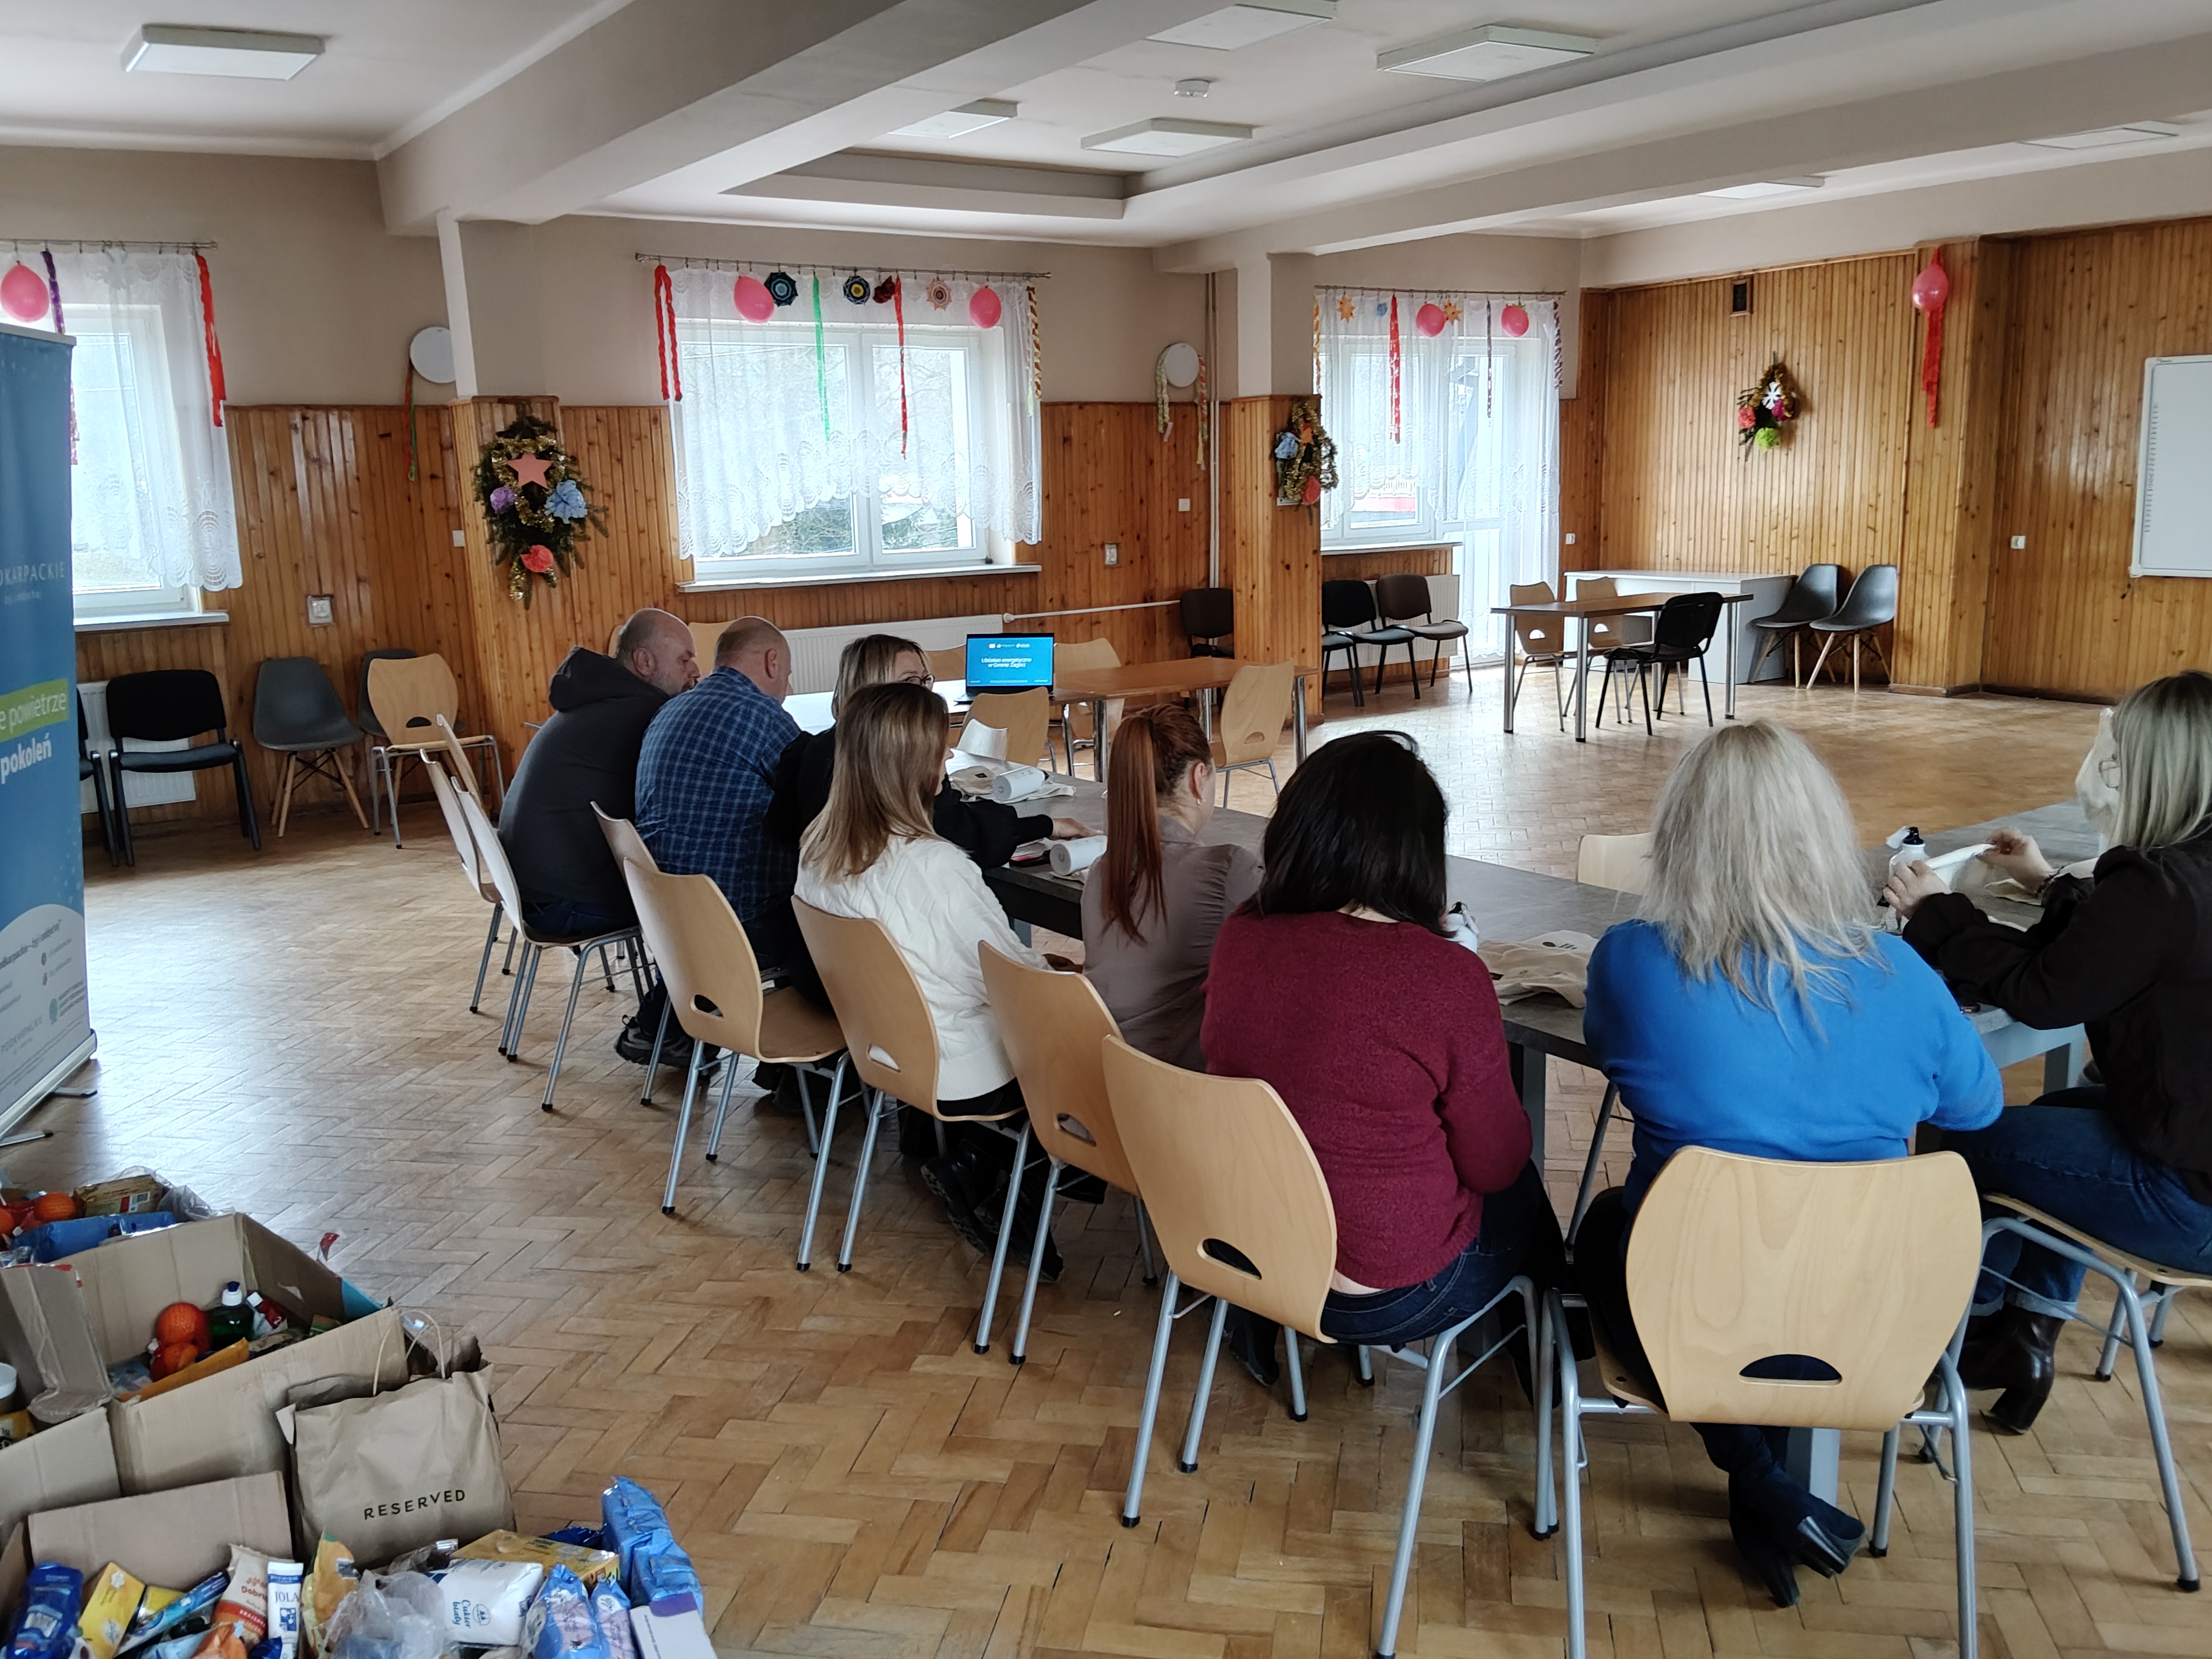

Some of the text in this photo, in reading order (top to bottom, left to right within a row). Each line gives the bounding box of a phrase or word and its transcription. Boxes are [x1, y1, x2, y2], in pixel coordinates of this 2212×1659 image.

[9, 692, 66, 734] powietrze
[1, 732, 52, 784] pokoleń
[364, 1489, 465, 1520] RESERVED
[461, 1599, 471, 1629] Cukier
